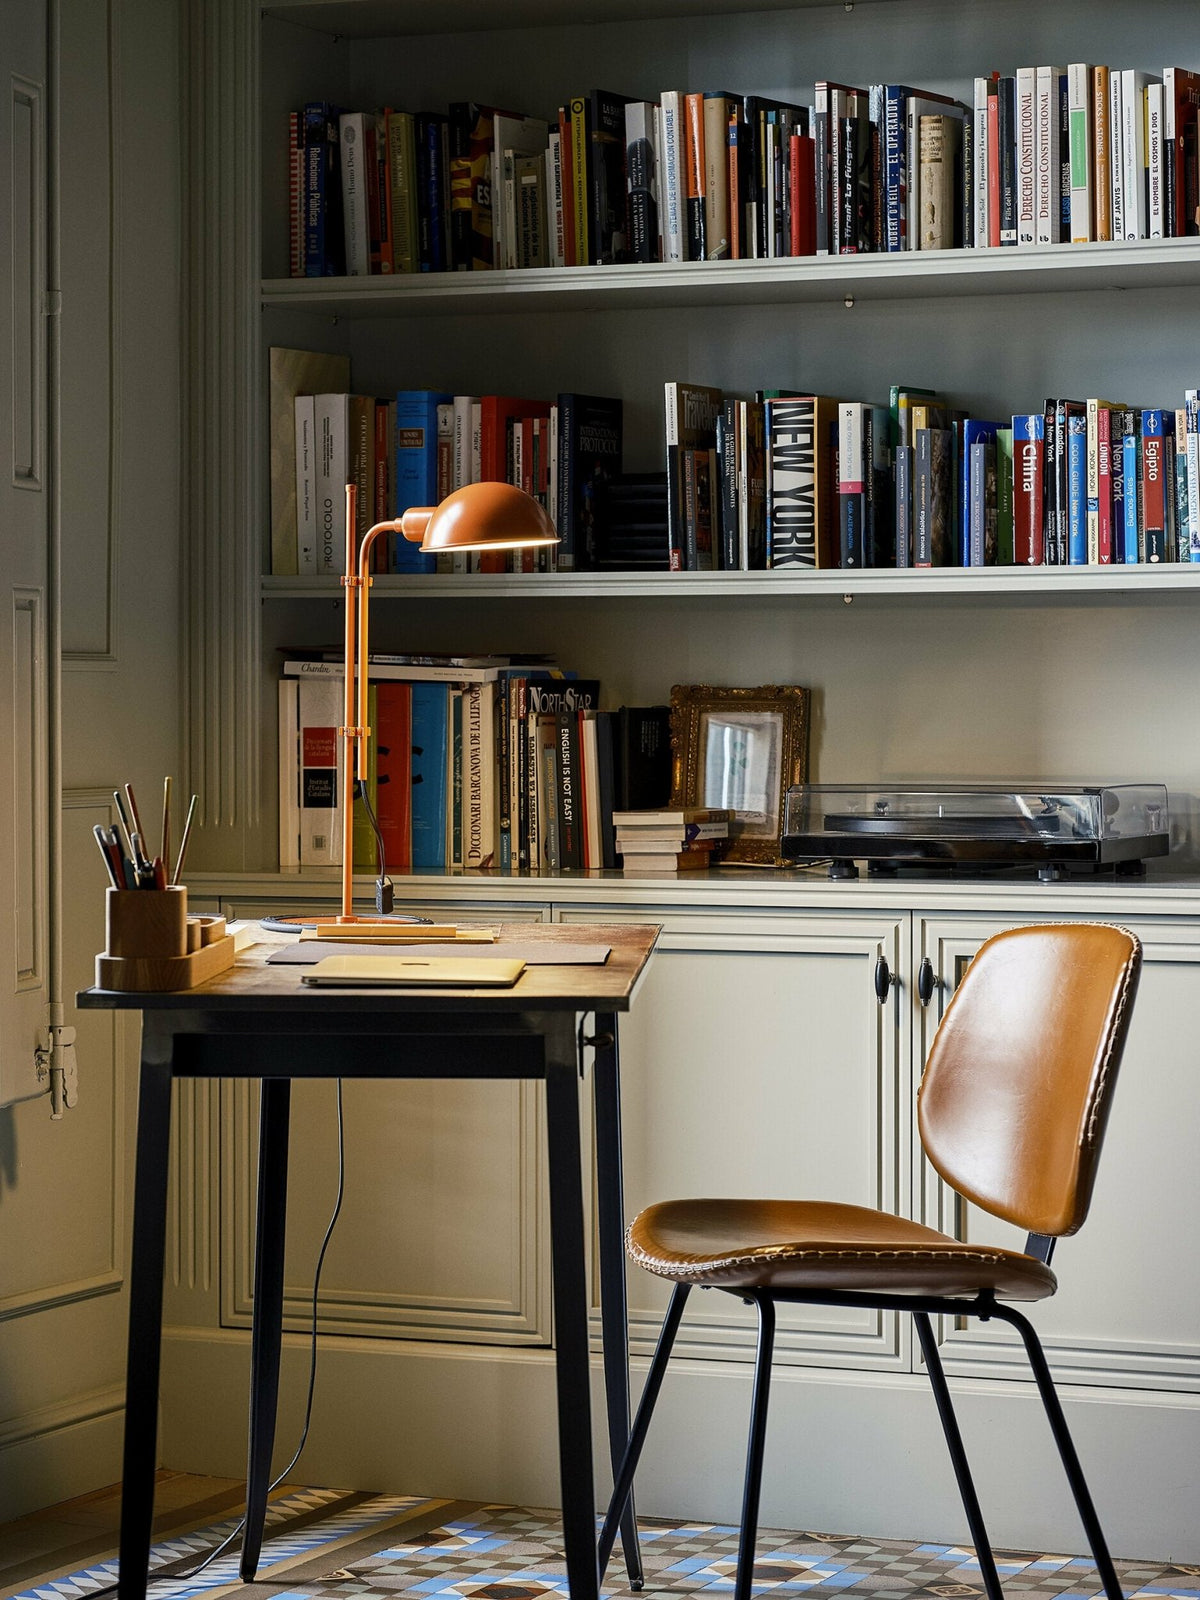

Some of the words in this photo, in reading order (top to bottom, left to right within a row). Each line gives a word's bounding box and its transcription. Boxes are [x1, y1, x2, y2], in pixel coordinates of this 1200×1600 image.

[665, 109, 675, 144] CONTABLE
[730, 132, 737, 140] 12
[886, 98, 899, 149] OPERADOR
[979, 114, 987, 139] empresa
[1019, 92, 1032, 175] CONSTITUCIONAL
[1038, 91, 1048, 177] CONSTITUCIONAL
[346, 147, 356, 168] Deus
[552, 141, 560, 163] LATERAL
[887, 153, 898, 164] EL
[309, 147, 321, 191] Relaciones
[347, 168, 357, 196] Homo
[553, 164, 561, 200] PENSAMIENTO
[979, 154, 988, 182] protocolo
[1060, 162, 1070, 196] BÁRCENAS
[1152, 164, 1158, 173] EL
[668, 191, 677, 201] DE
[844, 182, 852, 198] Lo
[887, 184, 898, 214] O'NEILL
[979, 183, 987, 191] El
[1020, 176, 1033, 221] DERECHO
[1038, 179, 1049, 218] DERECHO
[1113, 187, 1121, 215] JARVIS
[308, 192, 321, 227] Públicas
[520, 187, 529, 228] relaciones
[530, 186, 540, 232] Legislación
[554, 200, 562, 208] EL
[831, 168, 839, 241] PRESENTACIONES
[1061, 196, 1071, 214] CASO
[1152, 207, 1159, 216] EL
[669, 202, 678, 235] SISTEMAS
[844, 203, 852, 239] Tirant
[888, 216, 898, 247] ROBERT
[1061, 214, 1071, 224] EL
[1114, 216, 1122, 234] JEFF
[531, 233, 539, 244] de
[632, 214, 640, 253] DIPLOMACIA
[522, 230, 532, 267] laborales
[532, 246, 540, 257] las
[579, 437, 619, 455] PROTOCOL
[724, 433, 731, 441] DE
[729, 433, 736, 441] LA
[771, 402, 815, 474] NEW
[1047, 425, 1055, 443] New
[1057, 424, 1065, 455] London
[1047, 444, 1055, 462] York
[1072, 443, 1080, 469] COOL
[1099, 441, 1109, 475] LONDON
[1112, 444, 1124, 472] New
[1145, 441, 1160, 481] Egipto
[378, 460, 386, 487] Eventos
[685, 455, 693, 483] LONDON
[1021, 444, 1037, 492] China
[1072, 471, 1080, 497] GUIDE
[1112, 474, 1124, 502] York
[1126, 476, 1134, 497] Aires
[1072, 499, 1080, 517] New
[1126, 498, 1134, 527] Buenos
[1189, 476, 1197, 523] SHANGHAI
[323, 498, 334, 569] PROTOCOLO
[562, 515, 570, 545] PROTOCOL
[771, 483, 815, 568] YORK
[1072, 518, 1080, 537] York
[918, 535, 926, 559] Menorca
[301, 663, 331, 674] Chardin
[469, 721, 481, 731] LA
[470, 733, 481, 745] DE
[561, 728, 570, 765] ENGLISH
[470, 749, 481, 801] BARCANOVA
[546, 756, 554, 784] LONDON
[562, 767, 570, 775] IS
[562, 777, 571, 796] NOT
[563, 798, 572, 820] EASY
[468, 802, 481, 859] DICCIONARI
